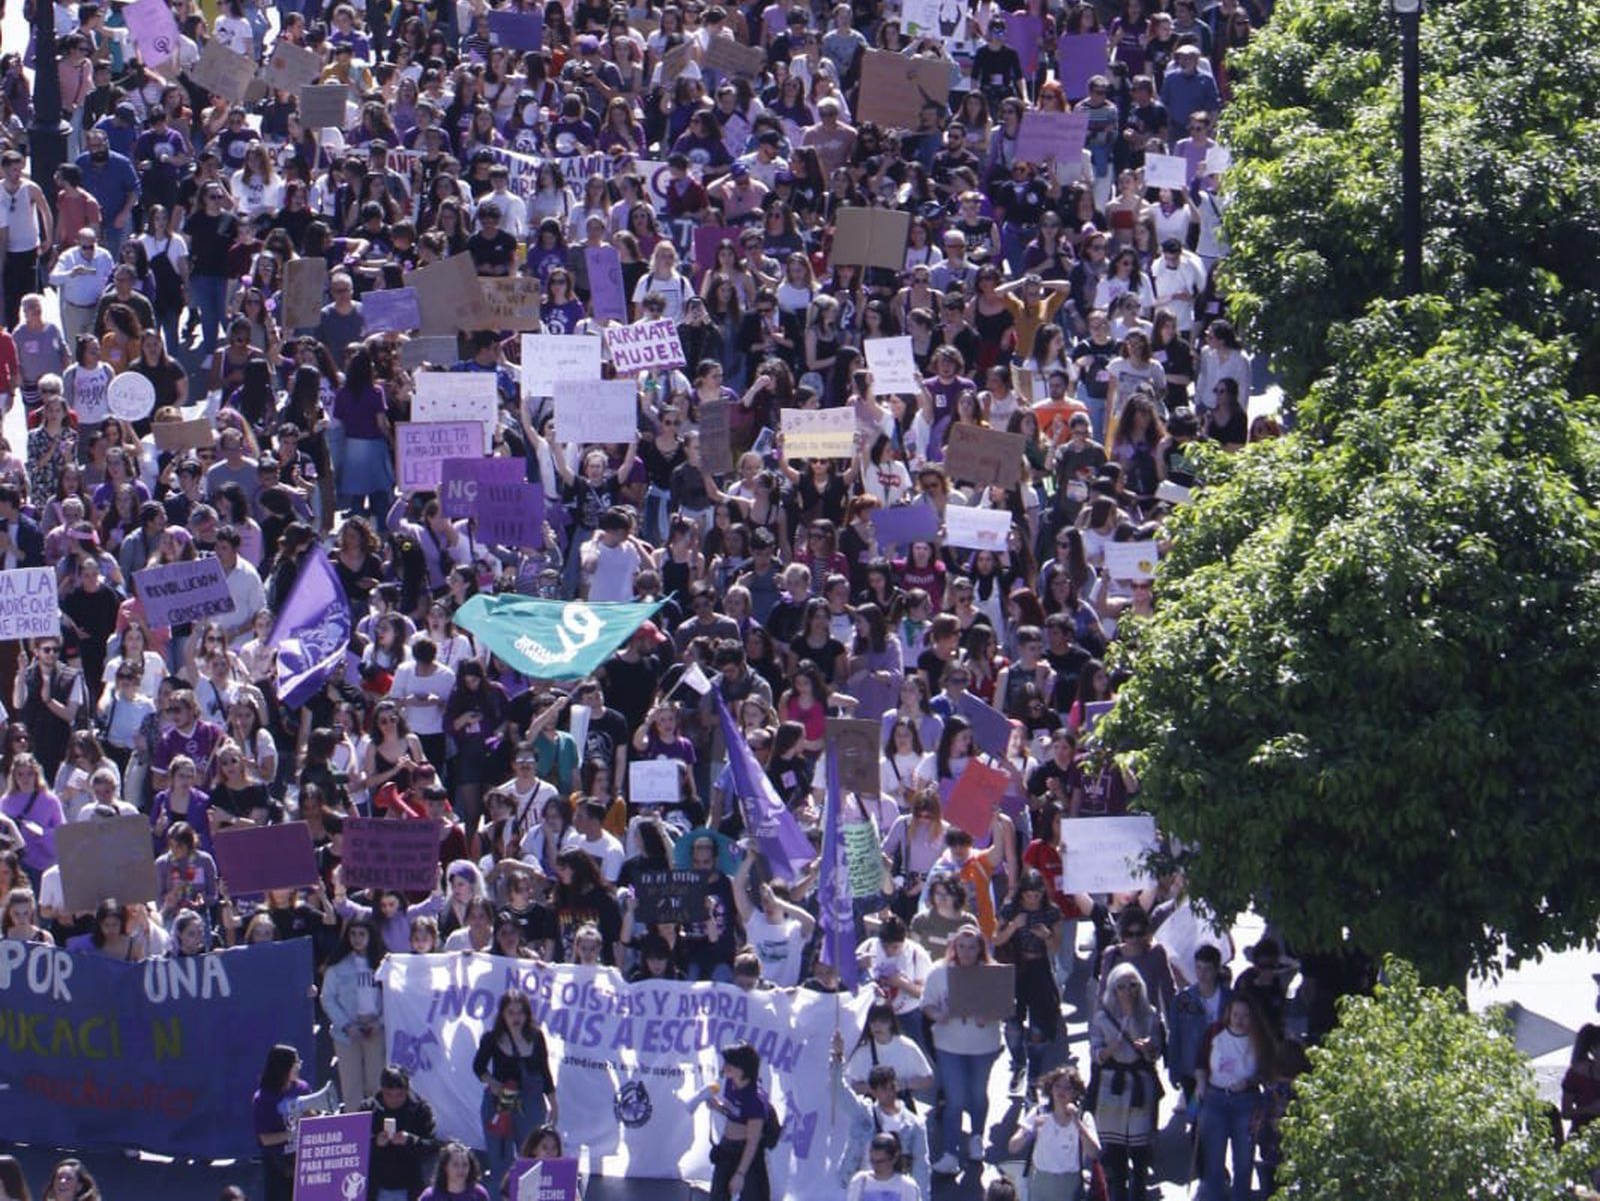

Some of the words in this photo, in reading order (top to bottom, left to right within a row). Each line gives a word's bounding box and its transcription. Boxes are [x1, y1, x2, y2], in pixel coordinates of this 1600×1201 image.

[614, 341, 682, 366] MUJER
[26, 572, 53, 595] LA
[30, 596, 55, 614] QUE
[345, 865, 433, 886] MARKETING
[0, 940, 74, 1003] POR
[143, 954, 232, 1004] UNA
[505, 967, 552, 1000] NOS
[652, 990, 670, 1015] Y
[677, 992, 748, 1021] AHORA
[426, 984, 496, 1024] ¡NO
[610, 1016, 633, 1050] A
[302, 1130, 343, 1146] IGUALDAD
[301, 1146, 314, 1159] DE
[314, 1143, 359, 1157] DERECHOS
[300, 1160, 323, 1172] PARA
[324, 1156, 361, 1169] MUJERES
[300, 1174, 306, 1185] Y
[306, 1171, 332, 1184] NIÑAS
